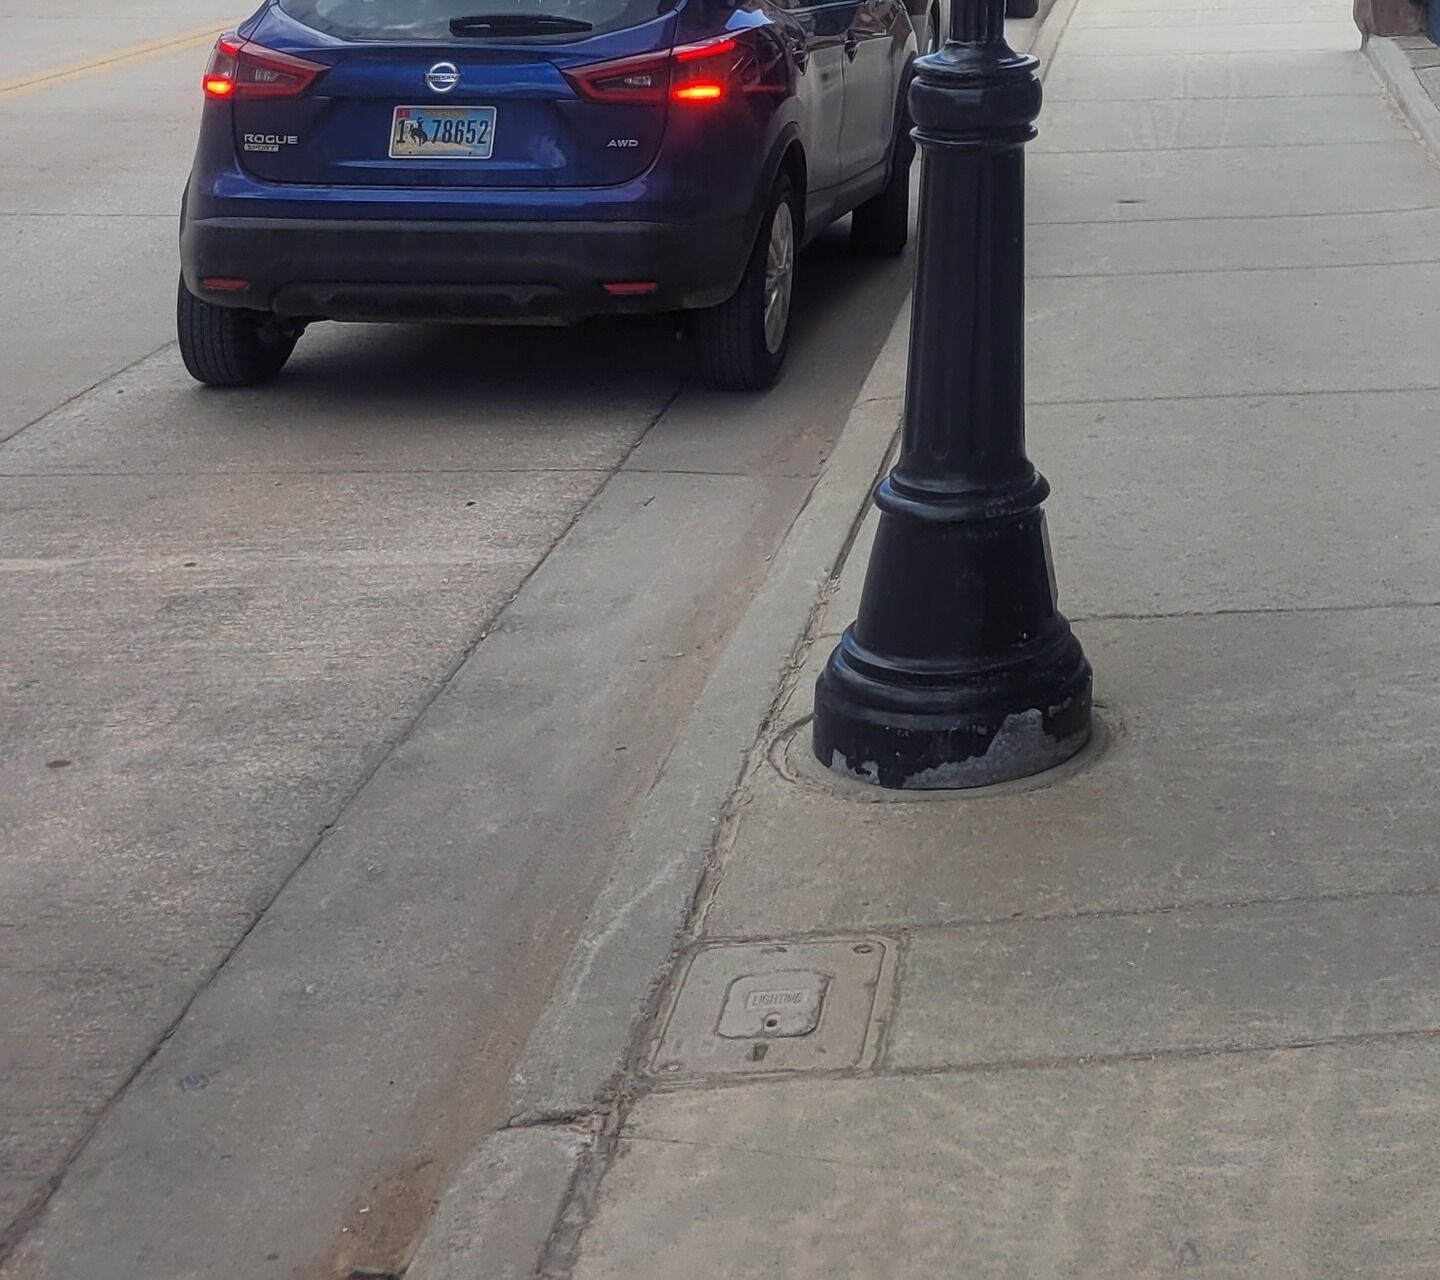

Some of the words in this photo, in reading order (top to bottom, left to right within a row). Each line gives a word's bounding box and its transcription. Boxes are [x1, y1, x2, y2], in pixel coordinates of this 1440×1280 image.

[431, 119, 489, 144] 78652
[244, 134, 298, 144] ROGUE
[607, 139, 639, 148] AWD
